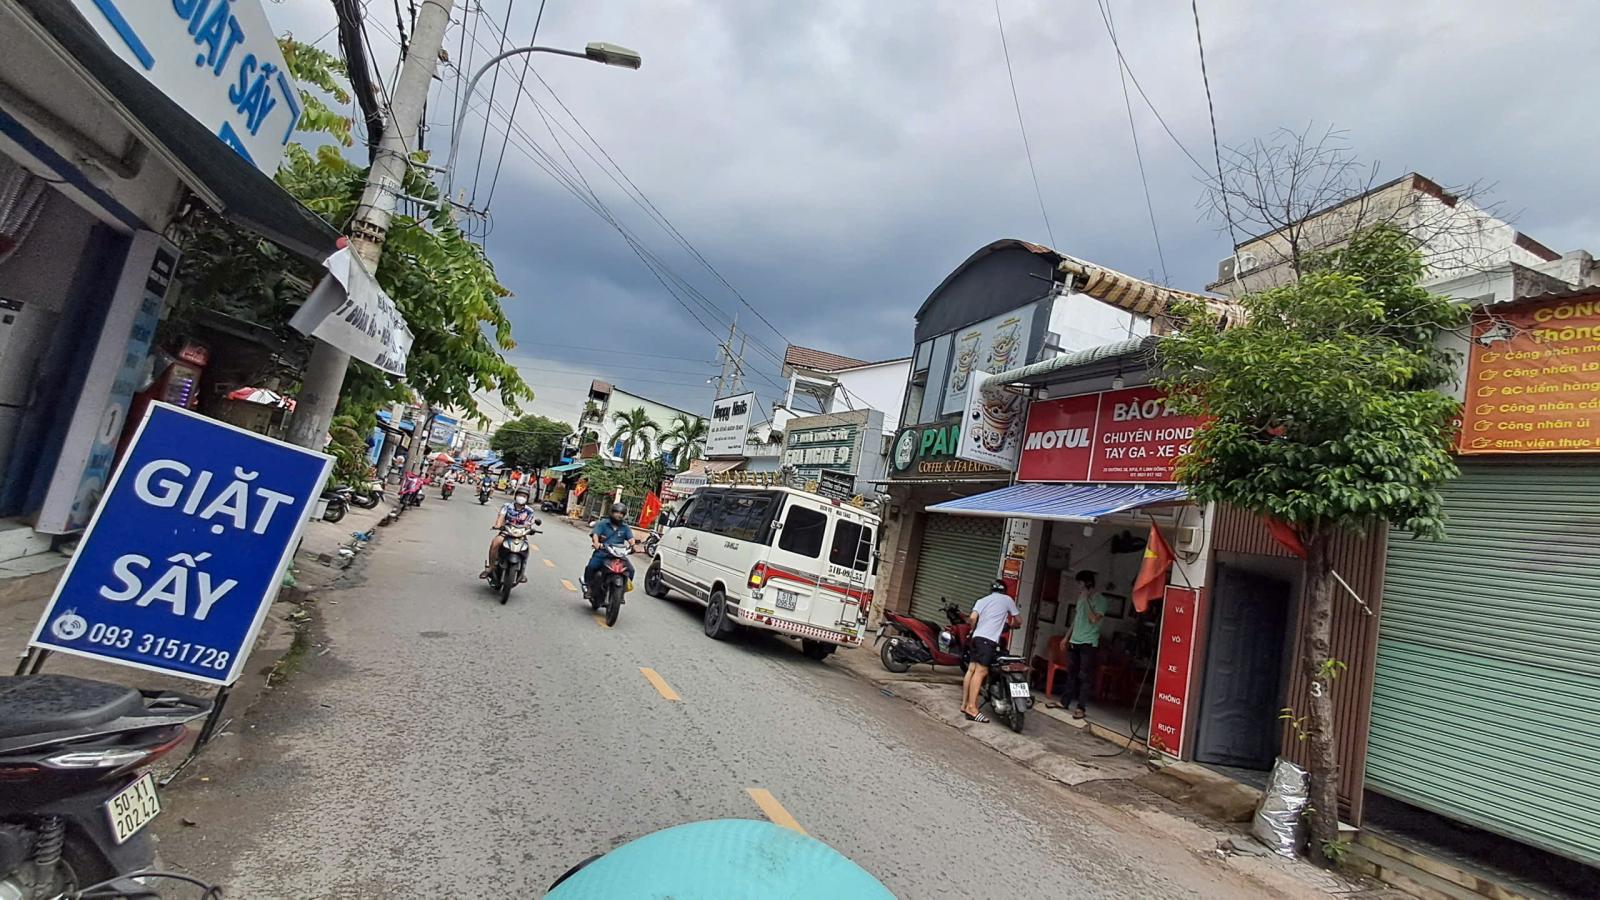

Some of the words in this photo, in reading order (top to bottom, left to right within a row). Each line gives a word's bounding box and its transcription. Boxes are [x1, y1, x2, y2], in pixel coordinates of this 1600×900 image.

[229, 54, 276, 136] SẤY
[1505, 351, 1540, 360] Công
[1503, 367, 1538, 378] Công
[1543, 364, 1577, 374] nhân
[1501, 386, 1523, 395] QC
[1526, 382, 1559, 393] kiểm
[1500, 403, 1535, 413] Công
[1539, 401, 1574, 410] nhân
[1497, 421, 1533, 431] Công
[1537, 420, 1572, 429] nhân
[1025, 428, 1090, 450] MOTUL
[1103, 428, 1152, 444] CHUYÊN
[1155, 427, 1195, 441] HOND
[1526, 439, 1554, 450] viện
[1559, 439, 1591, 449] thực
[1105, 446, 1126, 459] TAY
[1128, 446, 1146, 458] GA
[1156, 445, 1175, 457] XE
[918, 461, 943, 473] COFFEE
[944, 461, 951, 472] &
[952, 460, 967, 472] TEA
[134, 459, 295, 535] GIẶT
[99, 552, 238, 621] SẤY
[89, 623, 133, 648] 093
[137, 633, 230, 670] 3151728
[1168, 665, 1177, 673] XE
[1310, 681, 1321, 697] 3
[1159, 693, 1181, 705] KHÔNG
[1158, 723, 1176, 735] RUỘT
[114, 780, 148, 816] 50-X1
[117, 796, 157, 839] 202.42
